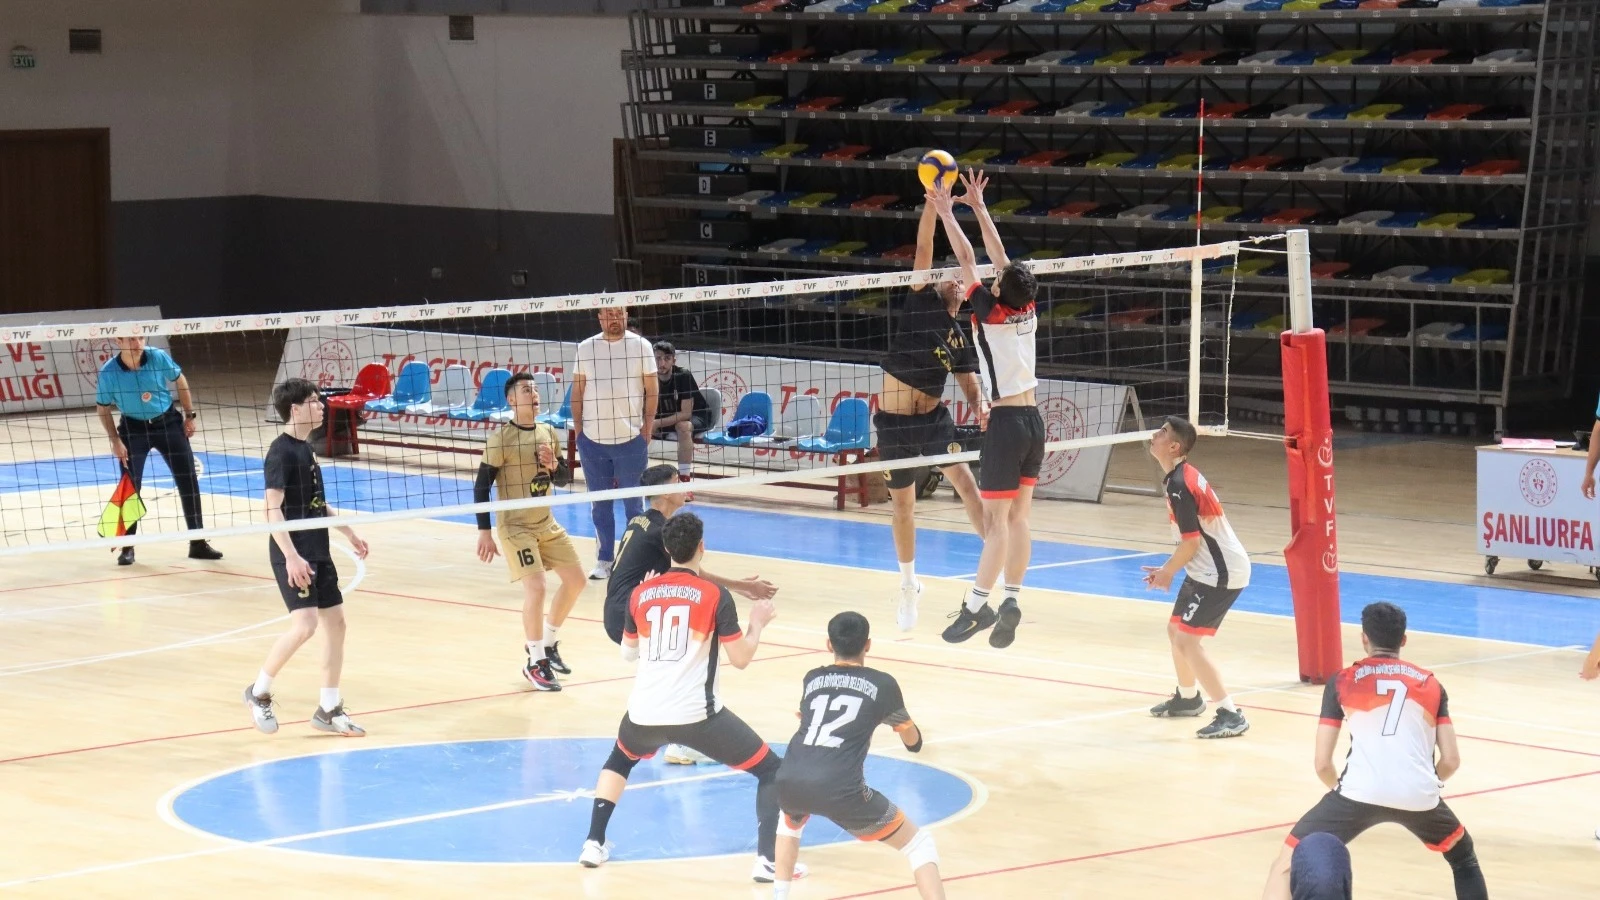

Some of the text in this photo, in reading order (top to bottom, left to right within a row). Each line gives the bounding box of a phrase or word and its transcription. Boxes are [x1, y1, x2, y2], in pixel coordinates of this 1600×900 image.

[13, 56, 33, 67] EXIT
[1111, 257, 1124, 265] TVF
[1141, 254, 1153, 262] TVF
[1052, 262, 1065, 270] TVF
[1082, 259, 1096, 267] TVF
[867, 277, 881, 286] TVF
[899, 275, 913, 283] TVF
[802, 282, 817, 291] TVF
[835, 280, 849, 288] TVF
[736, 287, 751, 295] TVF
[770, 285, 784, 293] TVF
[635, 294, 650, 303] TVF
[669, 292, 684, 300] TVF
[703, 290, 718, 298] TVF
[565, 299, 580, 308] TVF
[600, 297, 615, 305] TVF
[456, 306, 472, 315] TVF
[493, 304, 508, 312] TVF
[529, 302, 544, 310] TVF
[343, 313, 359, 322] TVF
[381, 311, 397, 319] TVF
[419, 309, 435, 317] TVF
[264, 317, 282, 327] TVF
[304, 315, 321, 324] TVF
[183, 322, 201, 332] TVF
[224, 320, 241, 329] TVF
[57, 328, 75, 338] TVF
[100, 327, 117, 336] TVF
[142, 325, 159, 334] TVF
[12, 330, 31, 339] TVF
[0, 367, 63, 403] LIĞI
[1323, 474, 1334, 537] TVF
[1483, 511, 1594, 551] ŞANLIURFA
[612, 529, 634, 572] 7
[516, 547, 535, 568] 16
[1182, 602, 1200, 622] 3
[645, 605, 691, 661] 10
[1376, 679, 1408, 736] 7
[803, 694, 864, 748] 12
